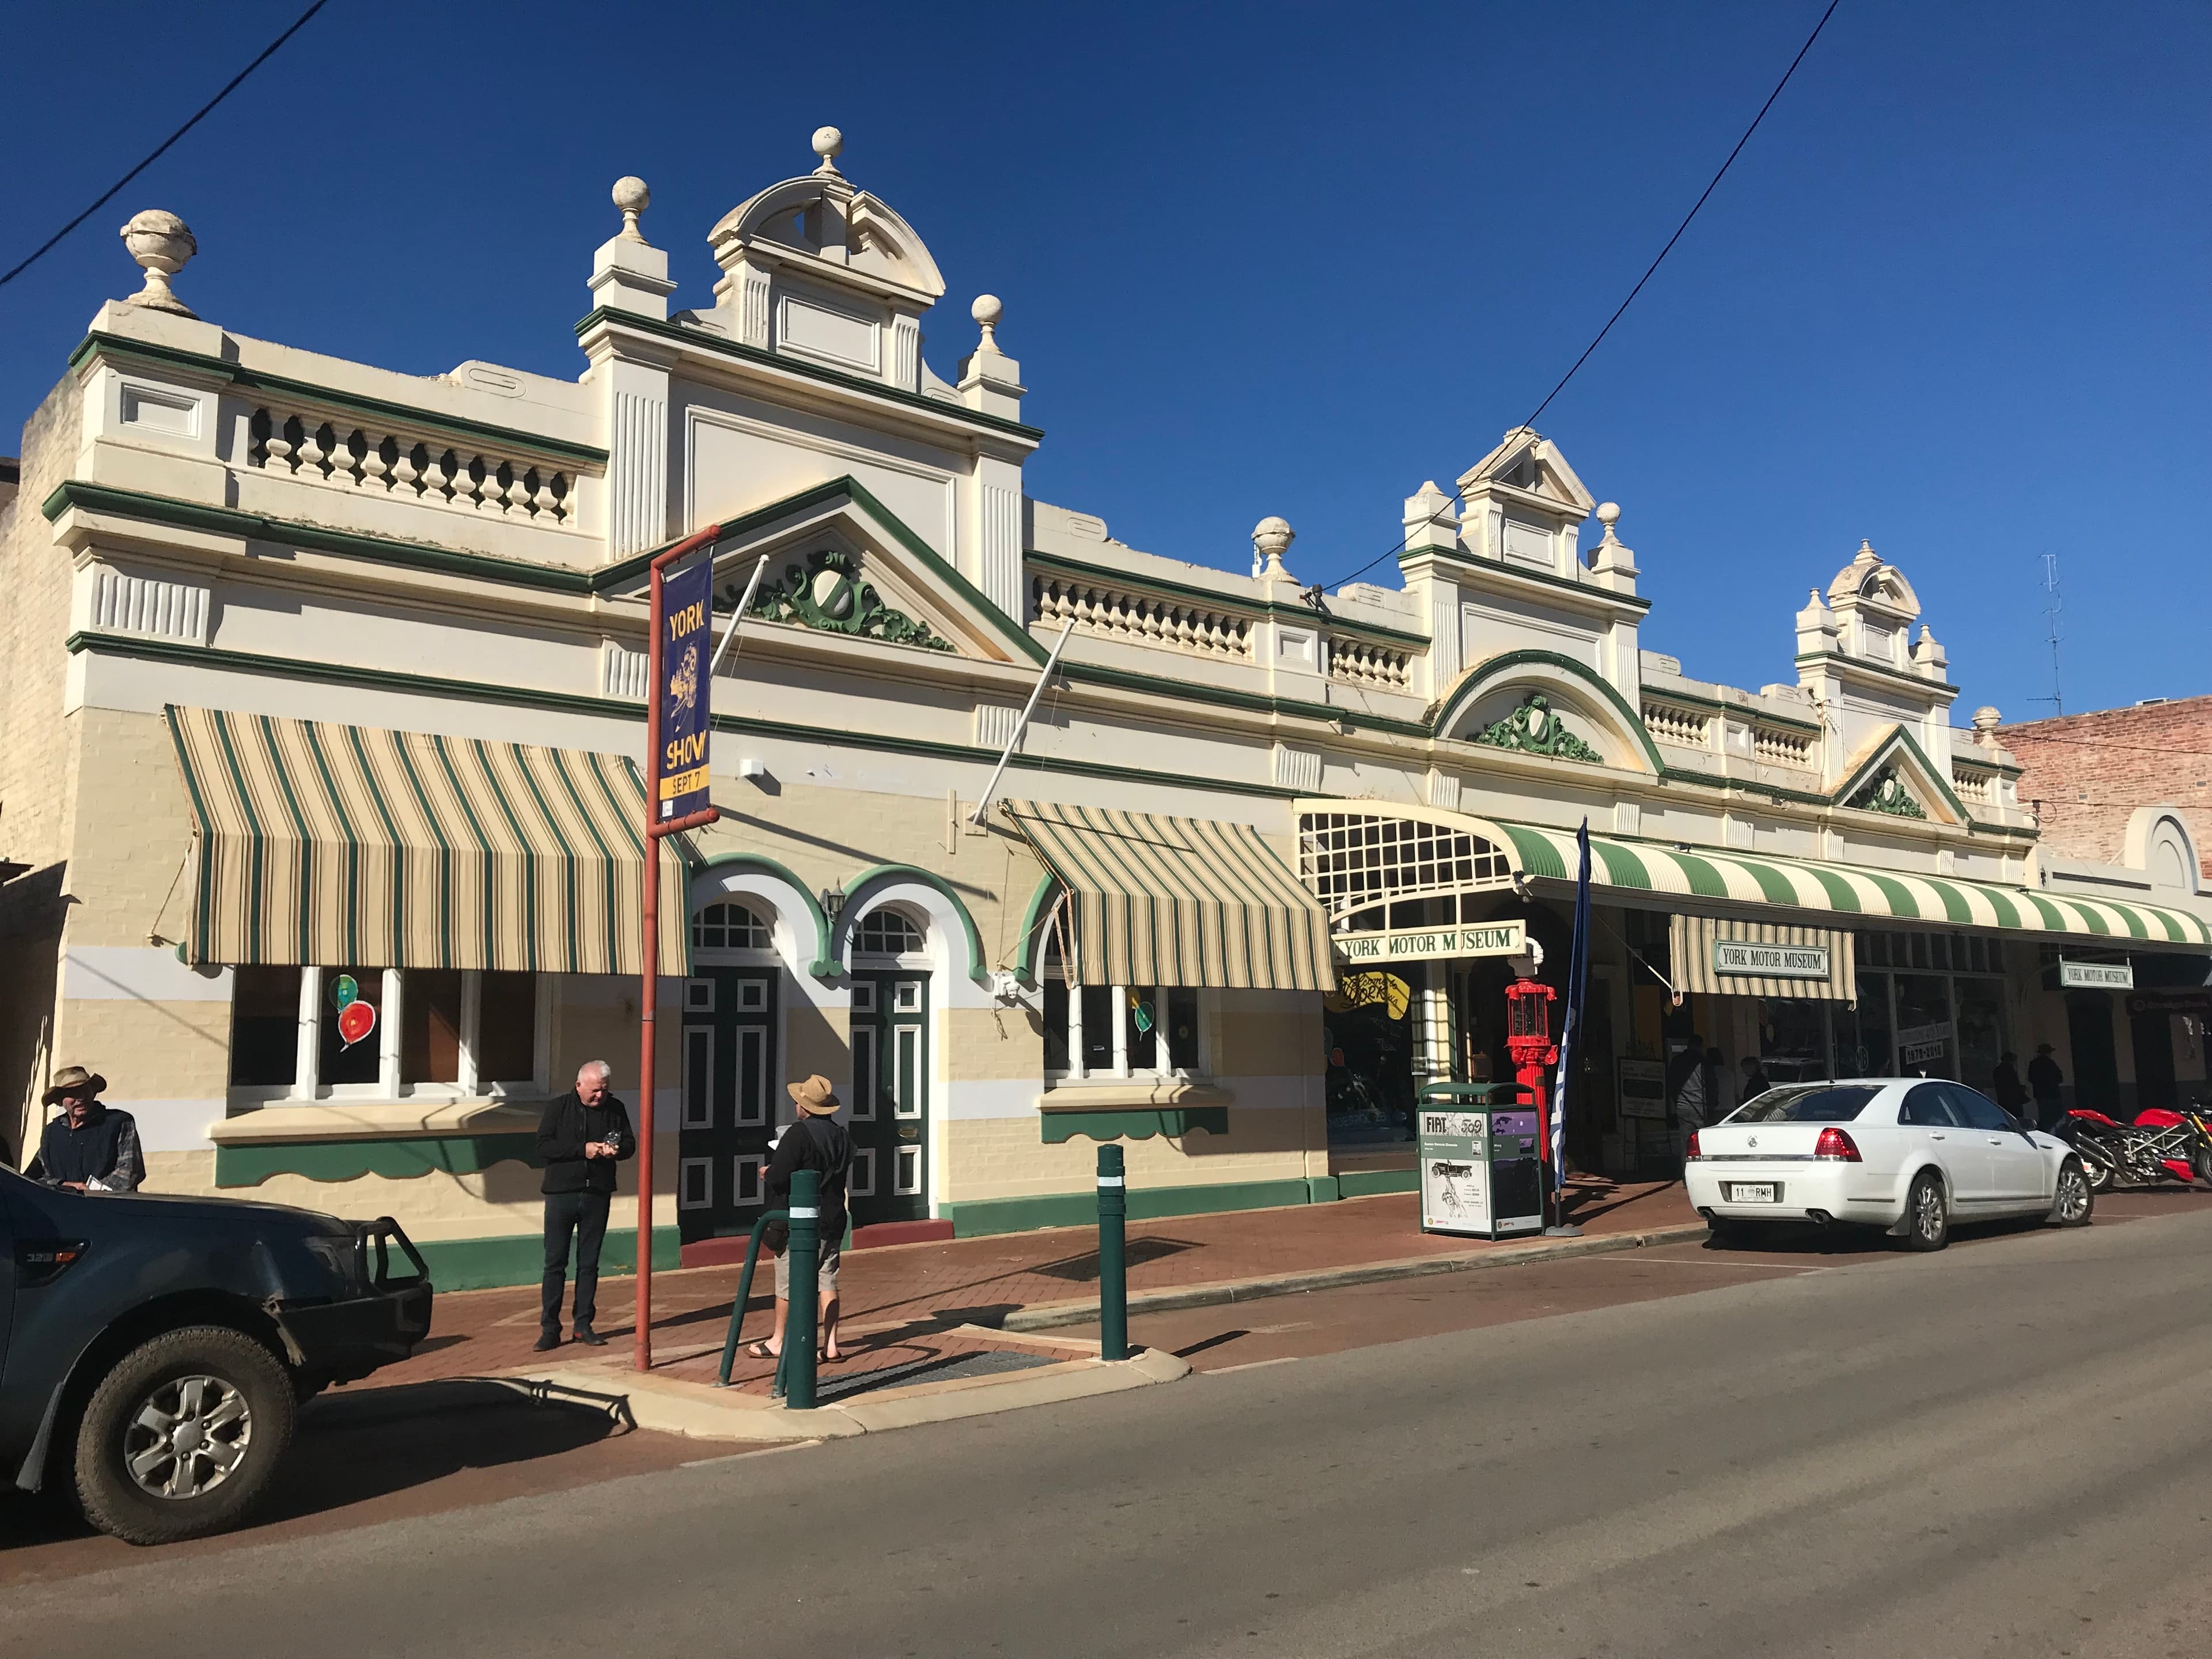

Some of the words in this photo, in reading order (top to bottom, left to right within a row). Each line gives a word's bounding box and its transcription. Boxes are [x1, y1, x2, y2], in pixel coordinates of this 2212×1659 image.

[670, 599, 704, 641] YORK
[666, 730, 706, 771] SHOW
[673, 776, 691, 795] SEPT
[694, 772, 700, 789] 7
[1344, 940, 1380, 957] YORK
[1390, 935, 1435, 955] MOTOR
[1443, 929, 1511, 950] MUSEUM
[1723, 948, 1747, 965] YORK
[1751, 950, 1781, 967] MOTOR
[1784, 952, 1821, 969] MUSEUM
[1389, 979, 1397, 989] to
[2067, 968, 2082, 981] YORK
[2084, 969, 2104, 982] MOTOR
[2105, 971, 2128, 984] MUSEUM
[1388, 994, 1398, 1006] WA
[1426, 1116, 1446, 1133] FIAT
[1461, 1119, 1482, 1134] 509
[1736, 1188, 1744, 1197] 11
[1756, 1188, 1771, 1197] RMH
